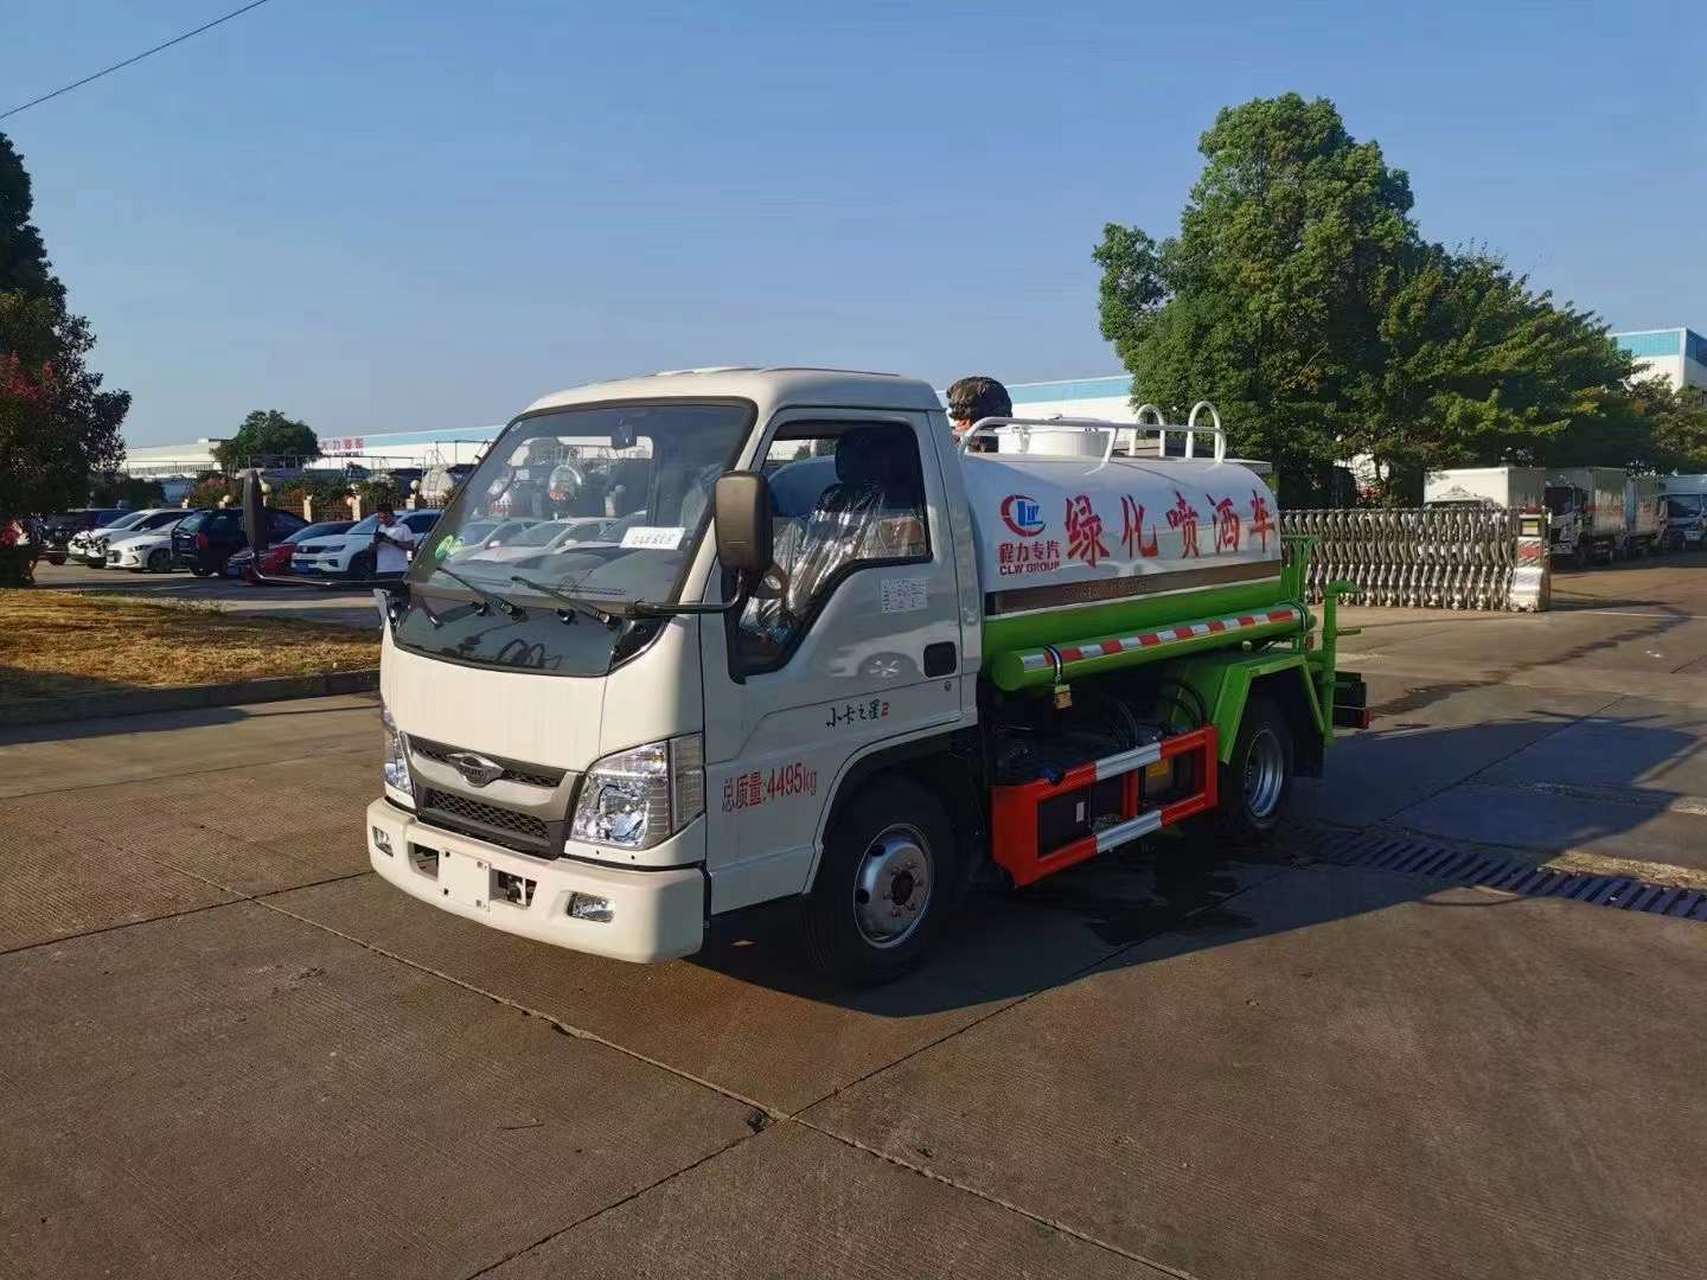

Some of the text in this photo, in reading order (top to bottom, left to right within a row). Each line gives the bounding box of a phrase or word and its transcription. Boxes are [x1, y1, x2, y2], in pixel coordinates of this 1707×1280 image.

[1000, 540, 1060, 564] 程力专汽
[999, 560, 1060, 576] CLW GROUP
